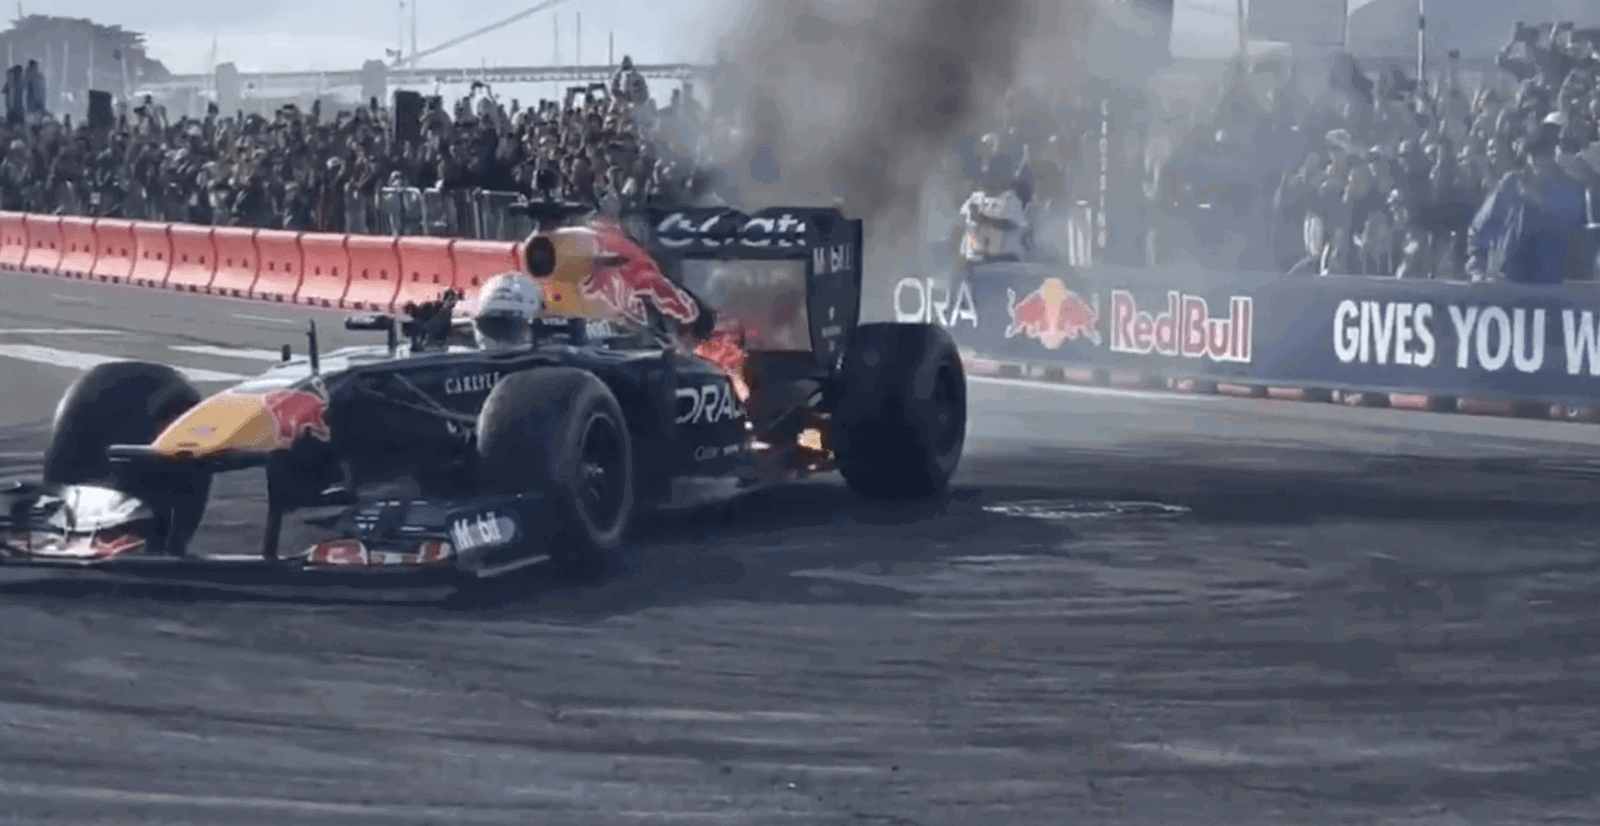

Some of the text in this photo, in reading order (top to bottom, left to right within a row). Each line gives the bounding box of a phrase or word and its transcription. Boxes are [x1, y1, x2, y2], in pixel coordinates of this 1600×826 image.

[1333, 299, 1436, 367] GIVES
[1448, 305, 1546, 373] YOU
[453, 510, 502, 550] Mbil
